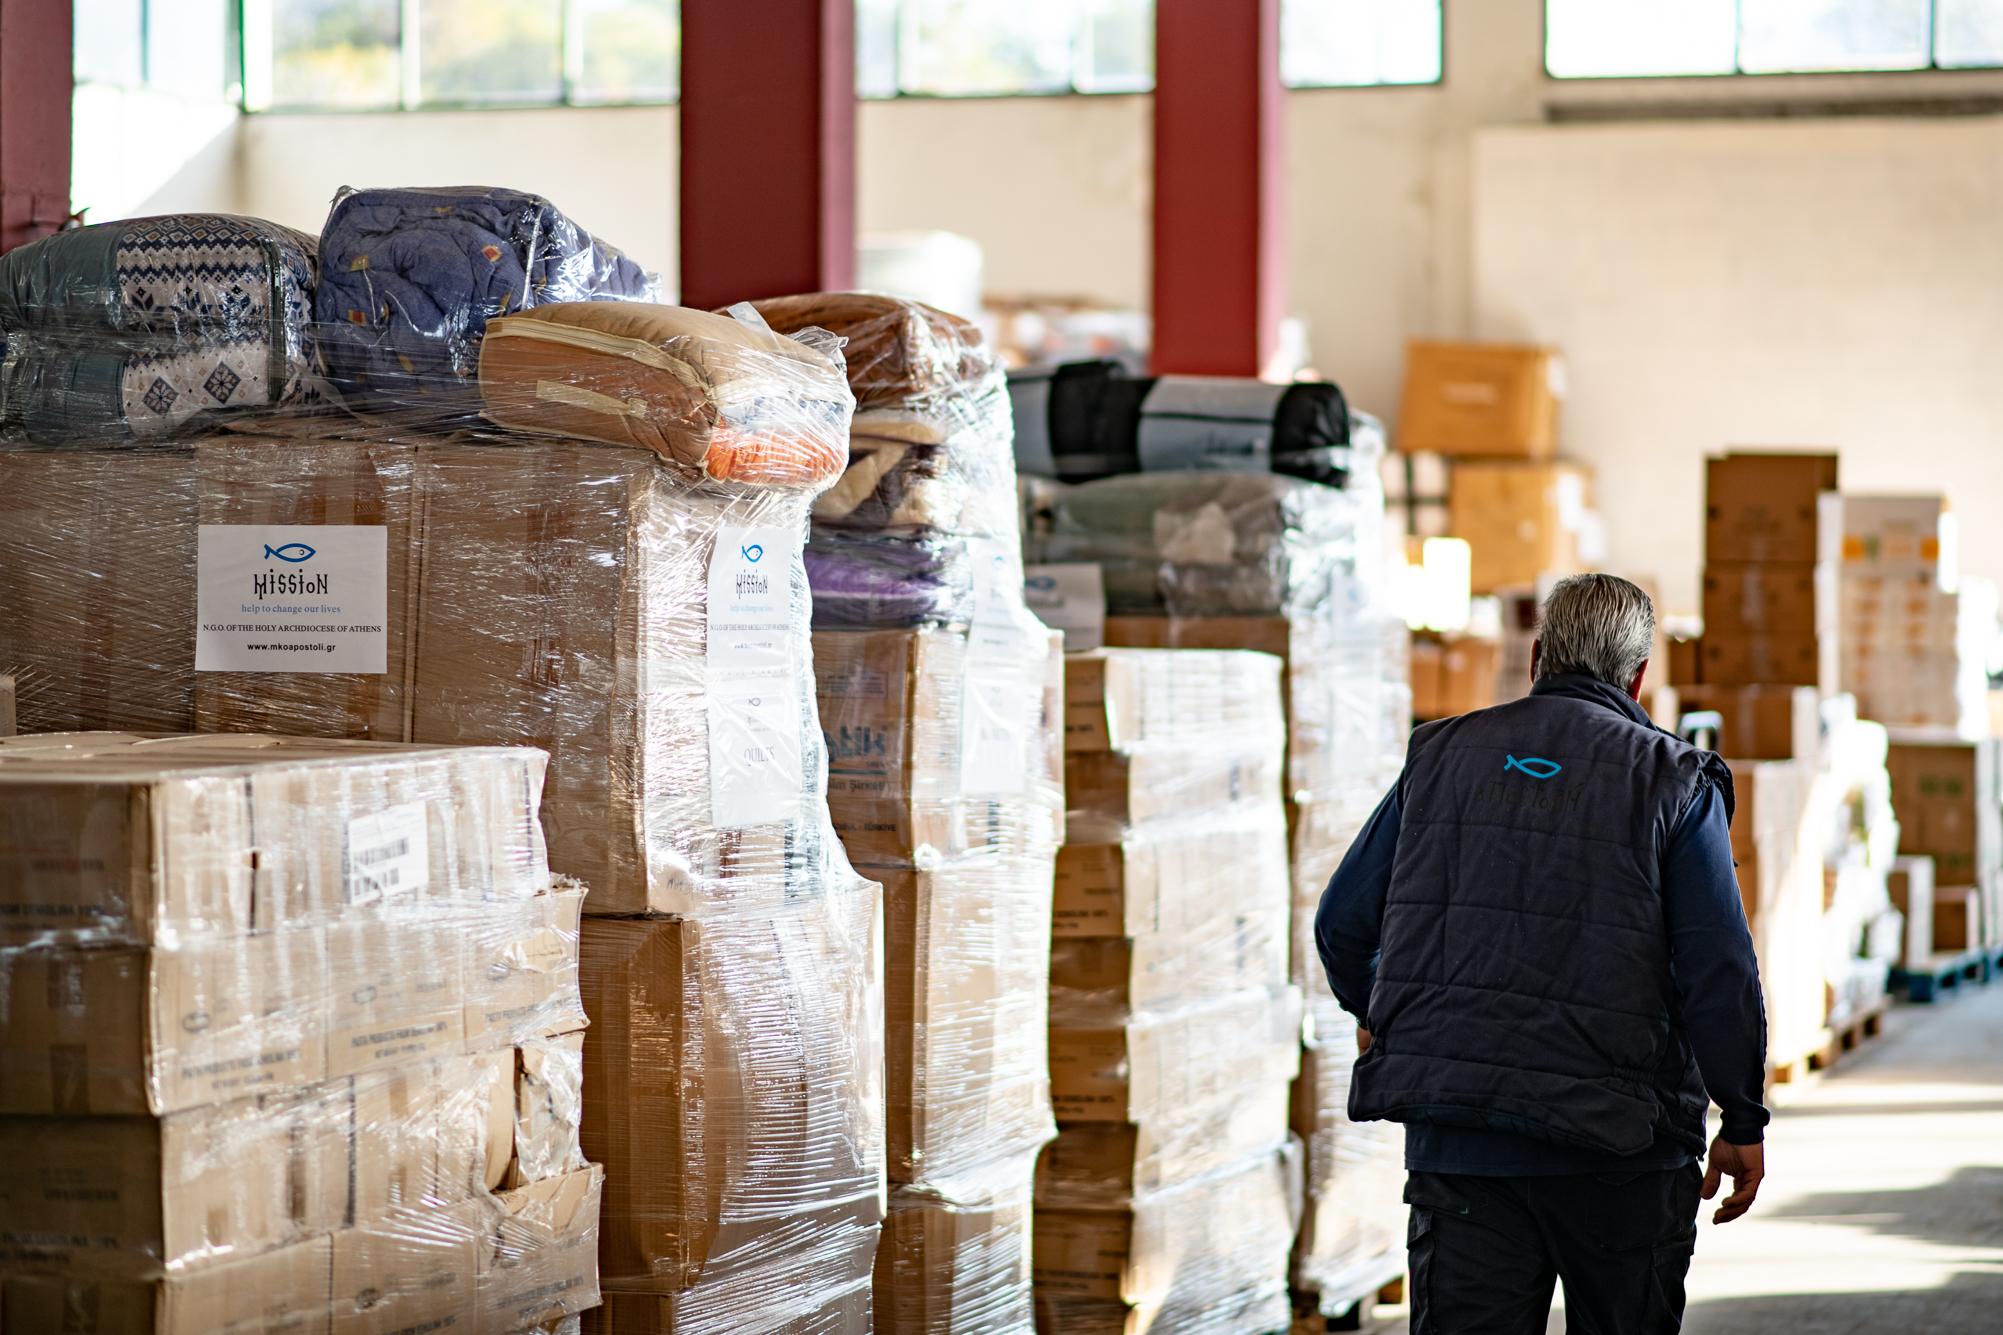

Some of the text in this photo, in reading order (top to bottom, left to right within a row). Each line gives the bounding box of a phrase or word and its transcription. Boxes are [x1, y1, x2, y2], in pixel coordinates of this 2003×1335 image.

[241, 604, 260, 615] help
[262, 605, 271, 613] to
[272, 604, 302, 615] change
[320, 604, 341, 613] lives
[203, 624, 382, 633] N.G.O. OF THE HOLY ARCHDIOCESE OF ATHENS
[246, 642, 336, 653] www.mkoapostoli.gr
